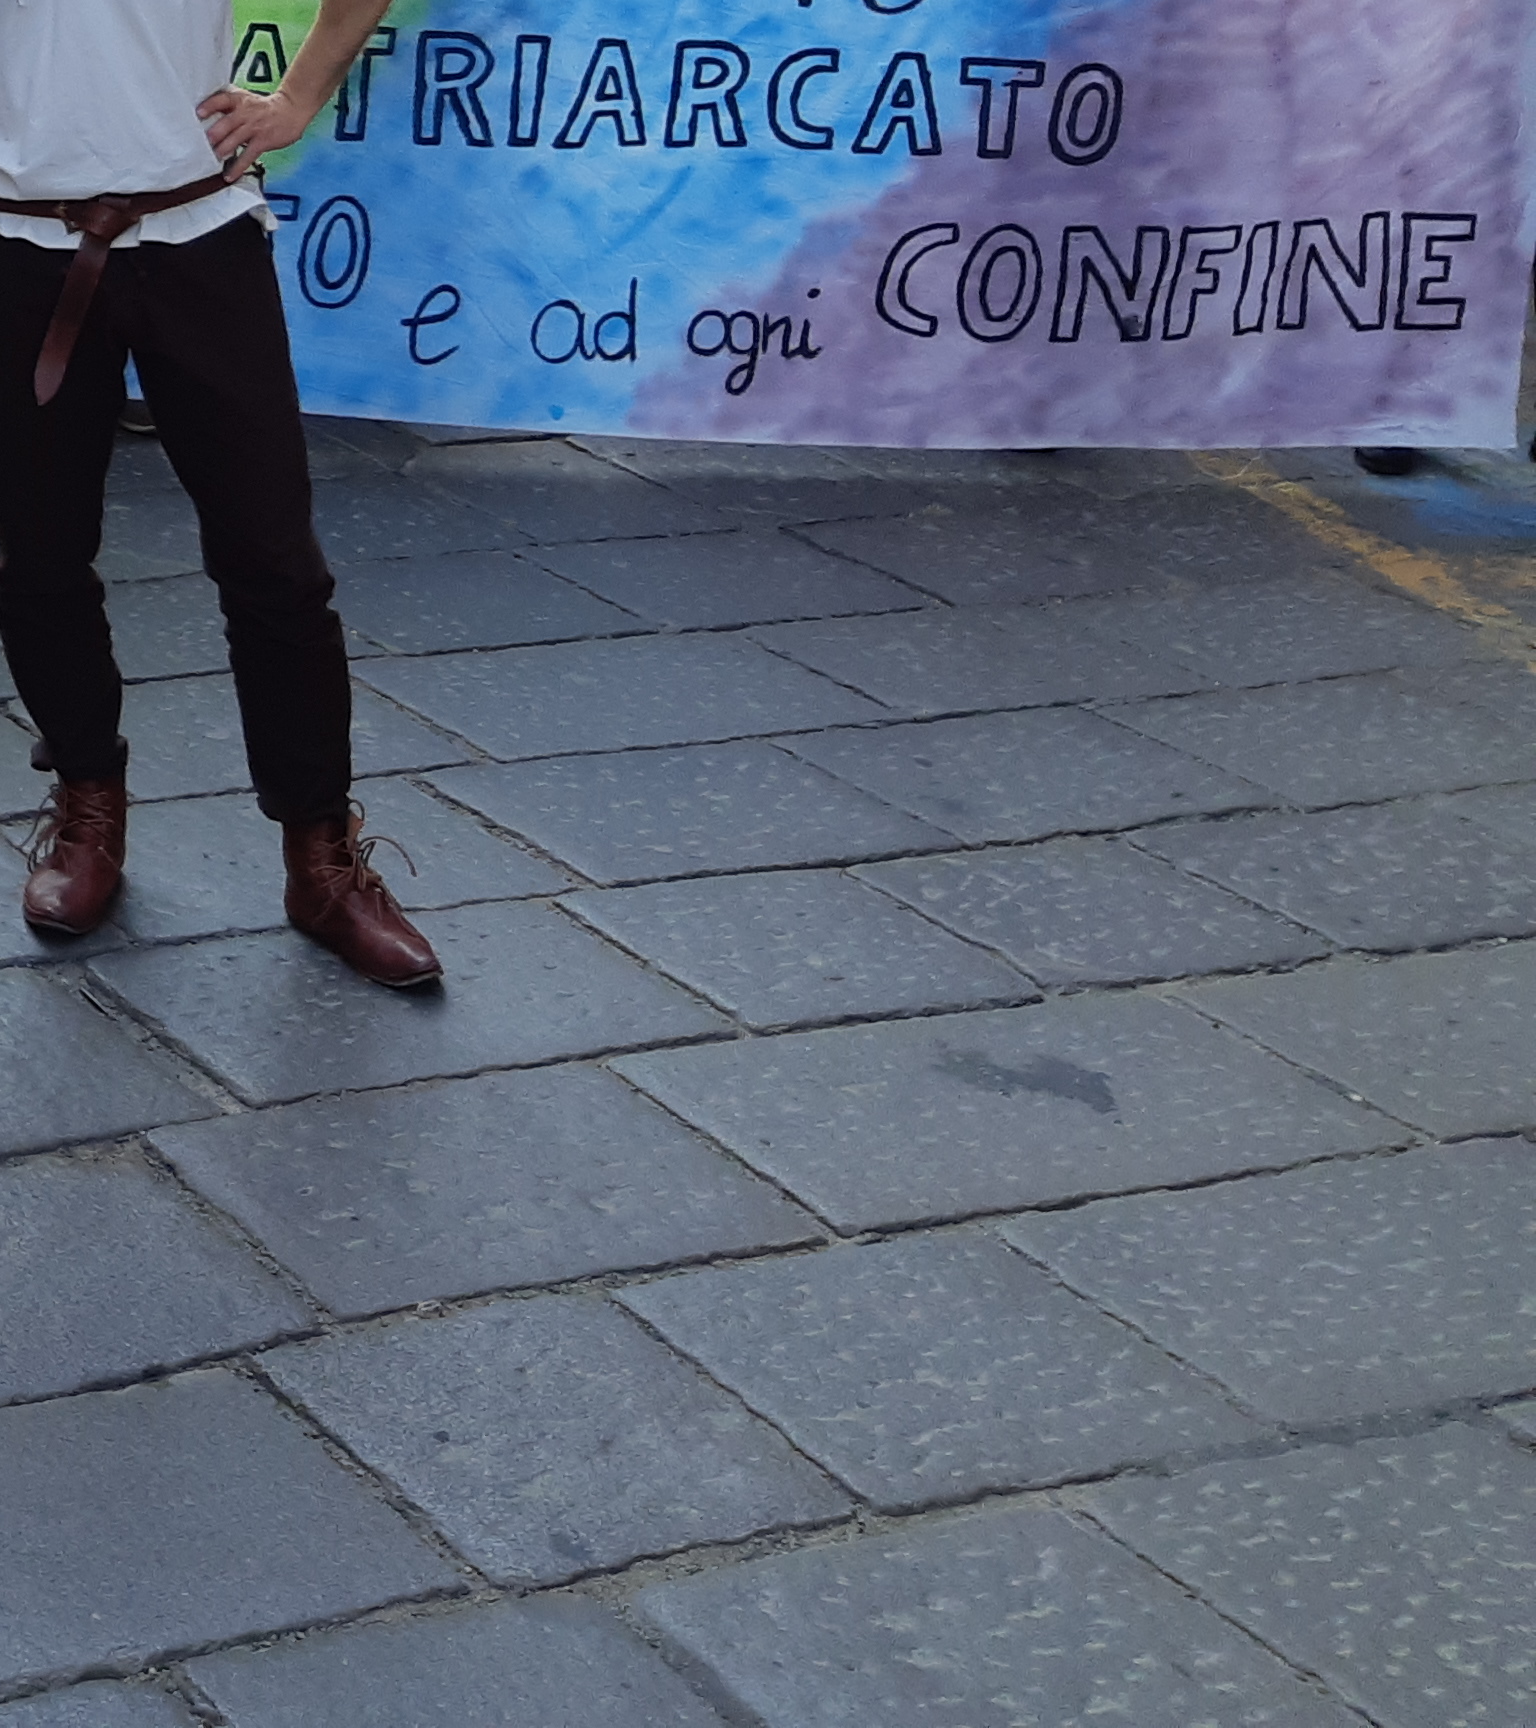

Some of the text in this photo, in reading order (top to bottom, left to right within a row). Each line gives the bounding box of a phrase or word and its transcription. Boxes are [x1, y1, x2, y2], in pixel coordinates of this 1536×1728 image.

[399, 283, 461, 366] e
[530, 277, 638, 365] ad
[687, 286, 823, 396] ogni
[877, 212, 1478, 345] CONFINE
